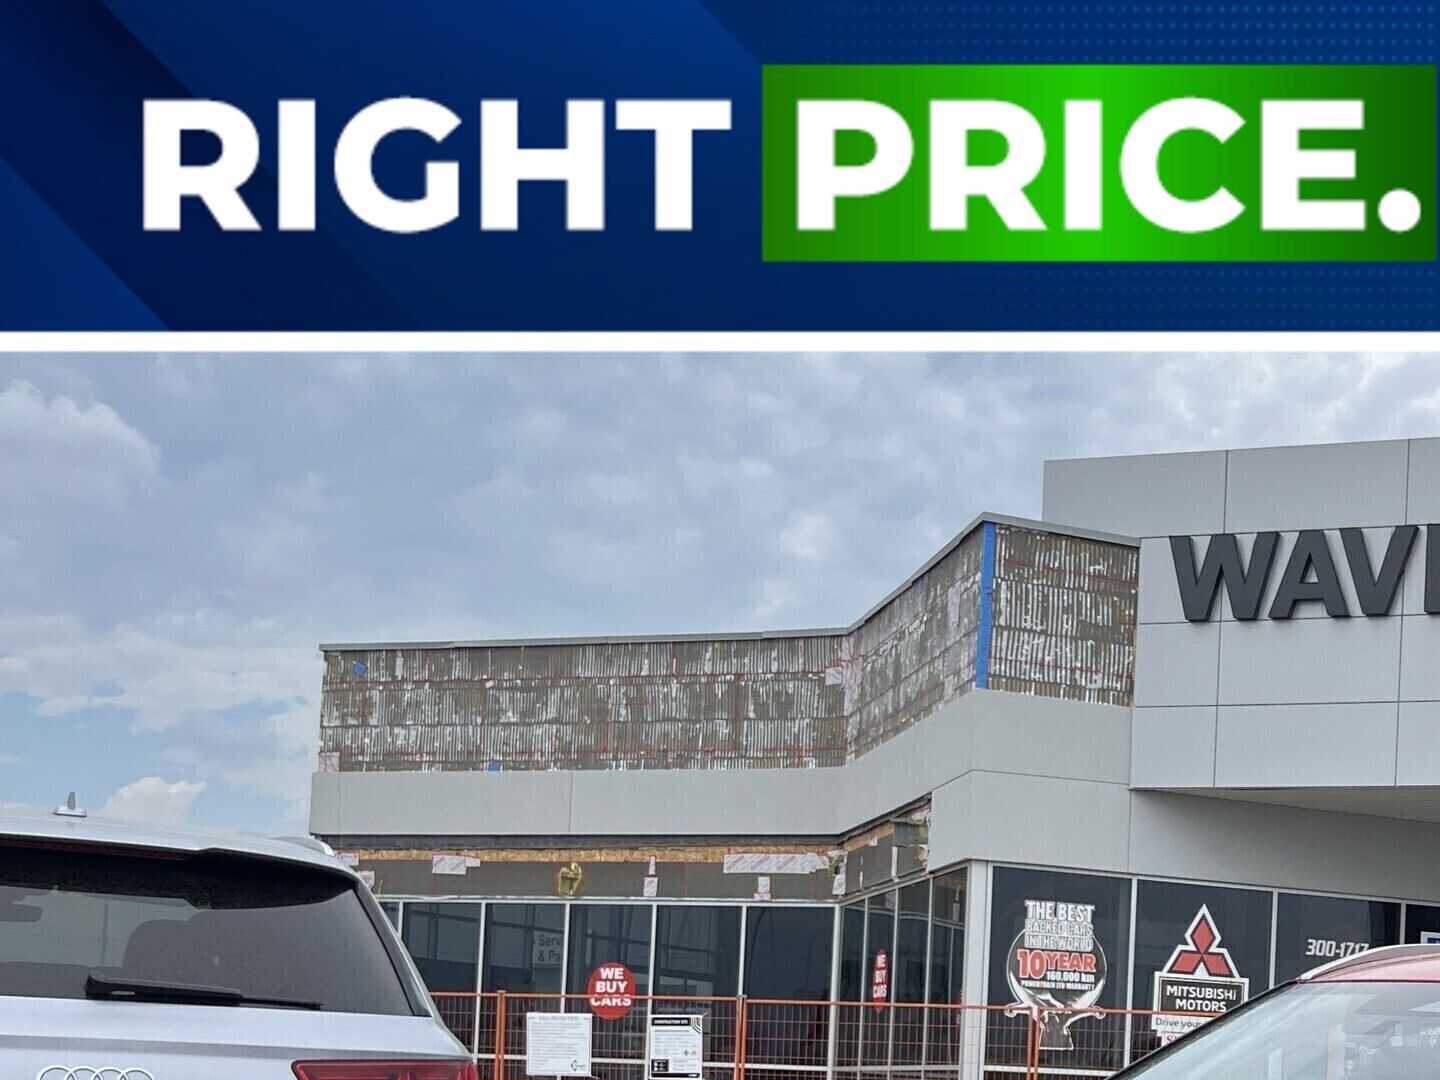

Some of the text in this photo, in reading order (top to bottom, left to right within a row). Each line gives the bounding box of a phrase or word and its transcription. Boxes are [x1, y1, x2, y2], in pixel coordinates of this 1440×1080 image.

[1024, 900, 1095, 923] THE BEST
[1026, 920, 1094, 936] BACKED CARS
[539, 934, 564, 946] Servi
[1025, 934, 1093, 951] IN THE WORLD
[1306, 939, 1369, 958] 300-1717
[538, 950, 545, 962] &
[1018, 949, 1096, 979] 10 YEAR
[600, 967, 624, 980] WE
[1081, 974, 1095, 983] km
[596, 981, 628, 993] BUY
[1166, 985, 1237, 1000] MITSUBISHI
[591, 994, 631, 1007] CARS
[1175, 998, 1227, 1013] MOTORS
[1155, 1017, 1180, 1026] Drive
